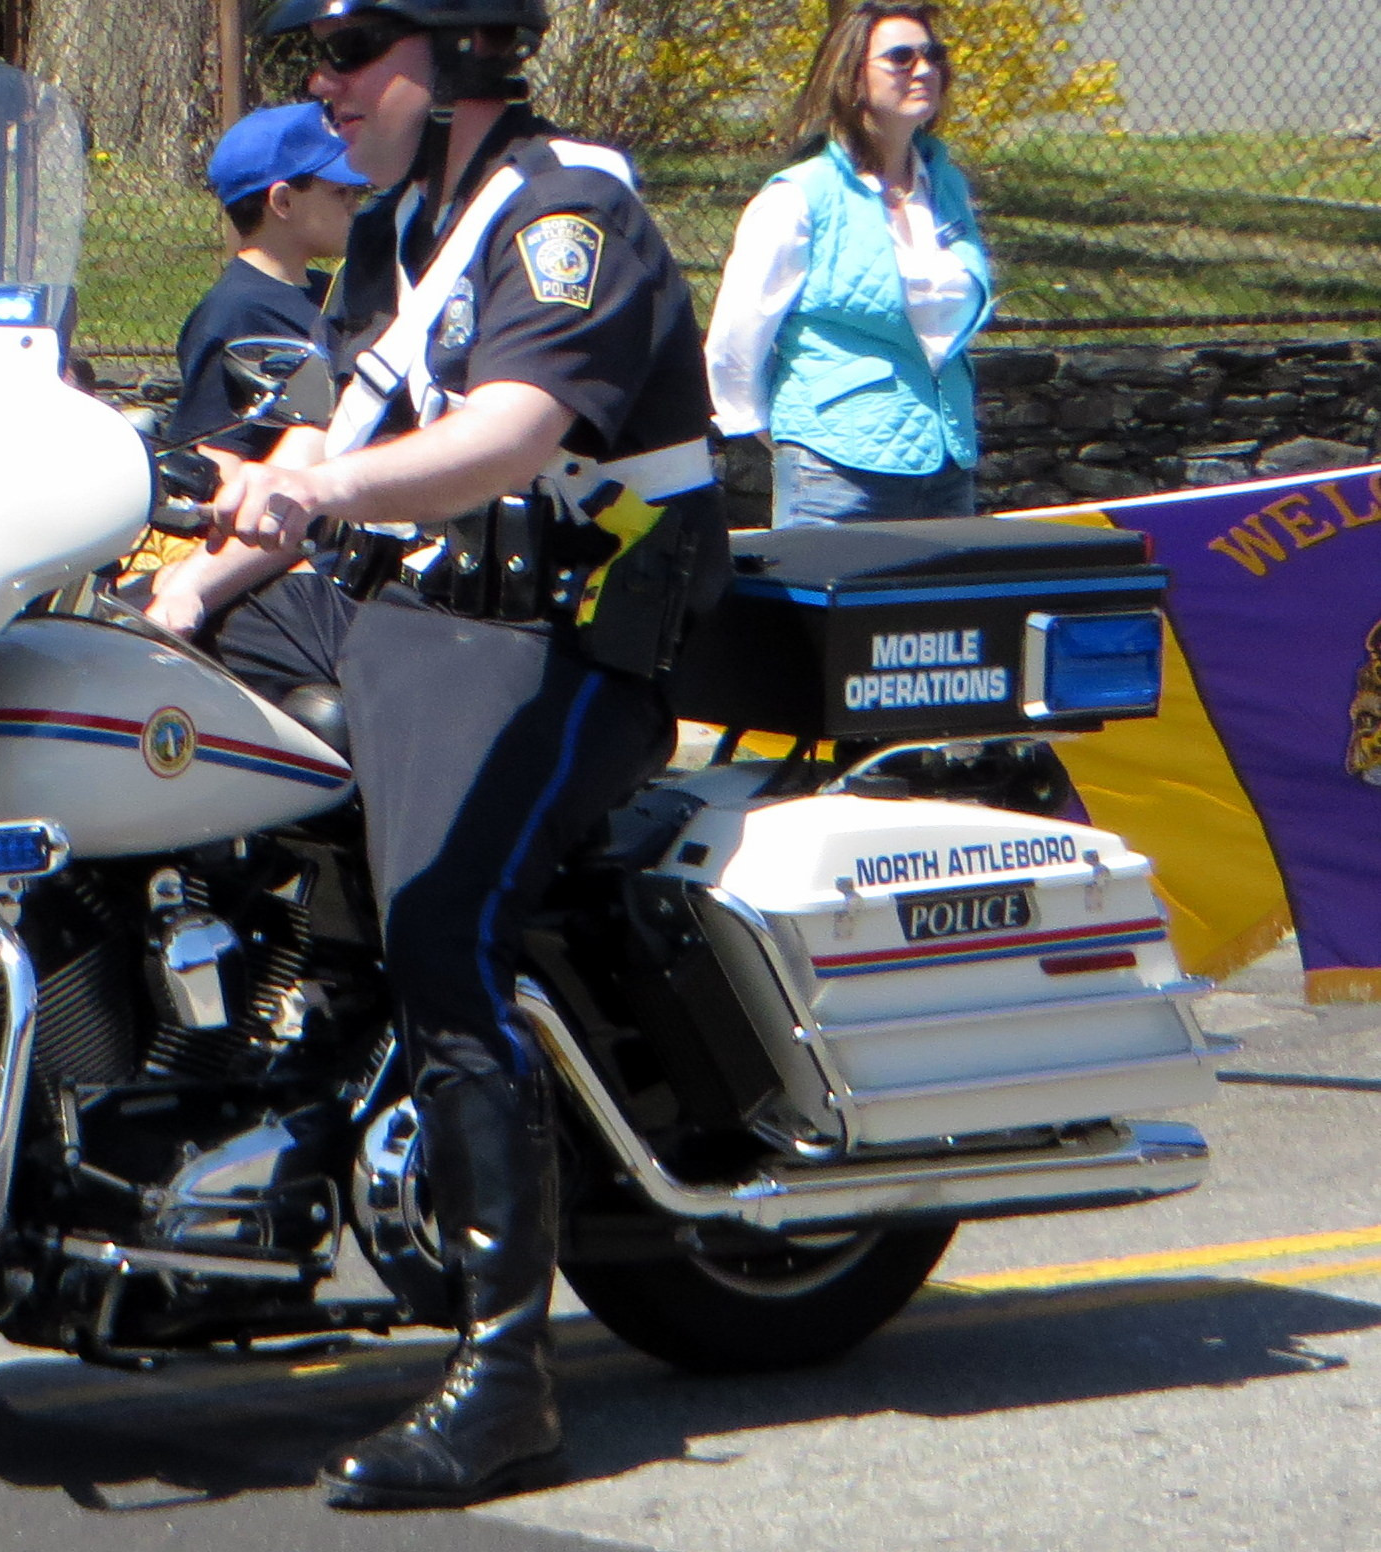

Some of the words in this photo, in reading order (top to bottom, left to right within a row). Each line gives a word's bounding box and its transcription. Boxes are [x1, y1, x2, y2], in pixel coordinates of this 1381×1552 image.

[526, 228, 596, 251] ATTLEBORO
[541, 219, 585, 233] NORTH
[541, 281, 587, 302] POLICE
[1208, 473, 1381, 576] WEL
[872, 629, 981, 668] MOBILE
[845, 666, 1008, 710] OPERATIONS
[856, 850, 939, 887] NORTH
[948, 834, 1076, 878] ATTLEBORO
[910, 893, 1020, 938] POLICE
